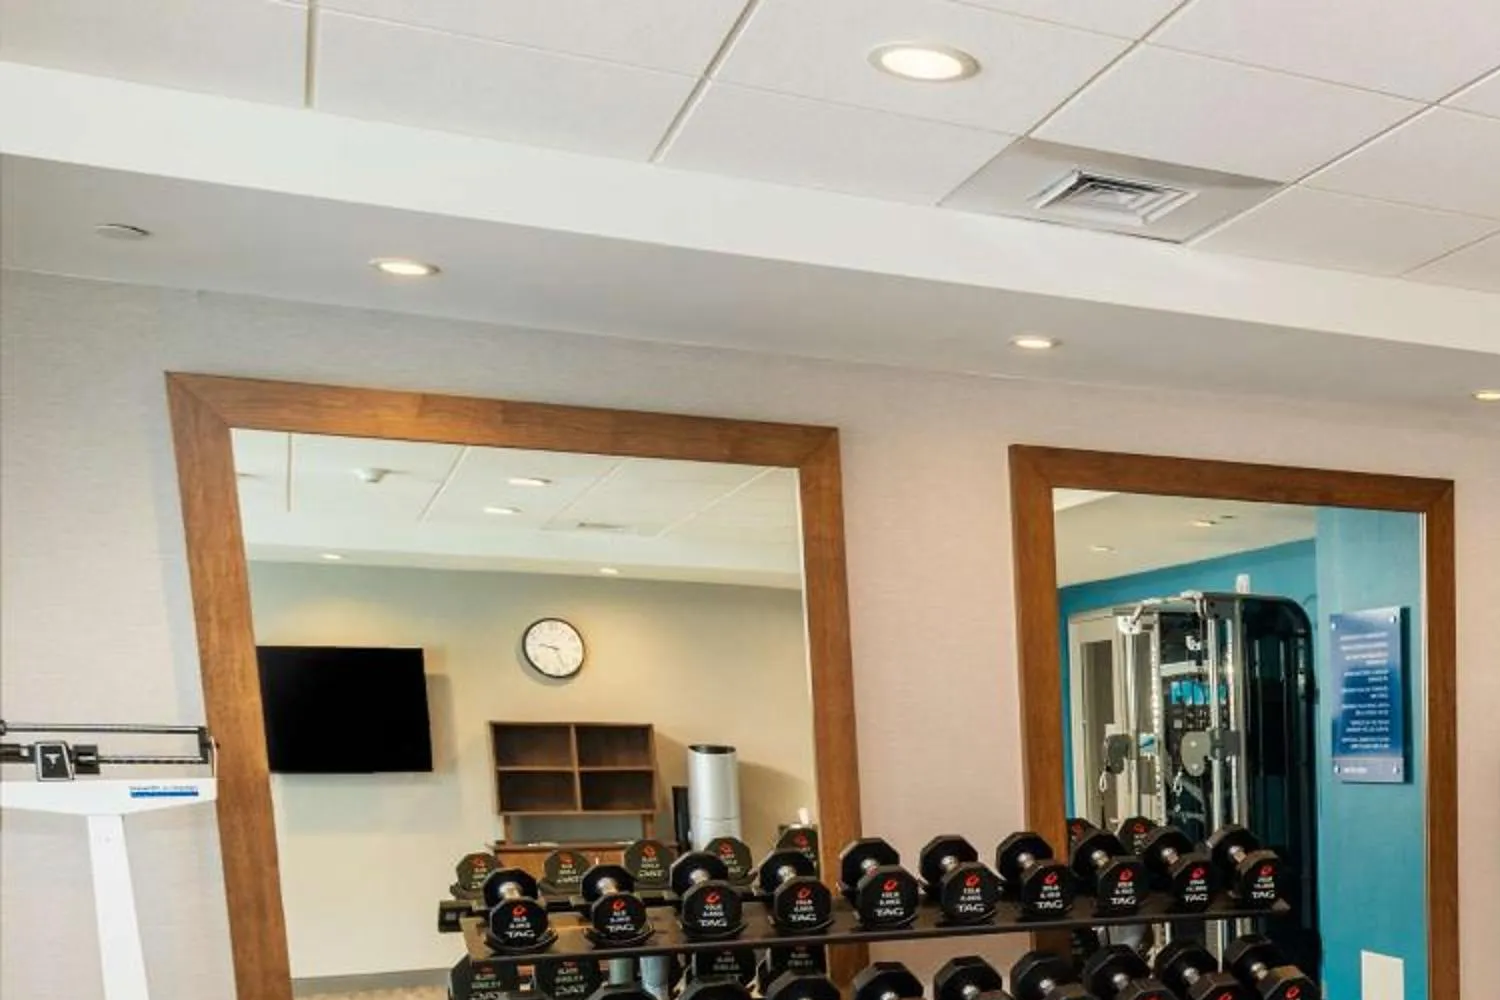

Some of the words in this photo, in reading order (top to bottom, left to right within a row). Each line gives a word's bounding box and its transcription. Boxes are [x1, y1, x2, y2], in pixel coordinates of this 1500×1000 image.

[1184, 893, 1208, 902] TAG
[1252, 890, 1275, 899] TAG
[1037, 900, 1063, 909] TAG
[1110, 896, 1136, 905] TAG
[874, 907, 904, 917] TAG
[956, 904, 984, 913] TAG
[789, 914, 817, 922] TAG
[606, 923, 636, 932] TAG
[504, 930, 535, 939] TAG
